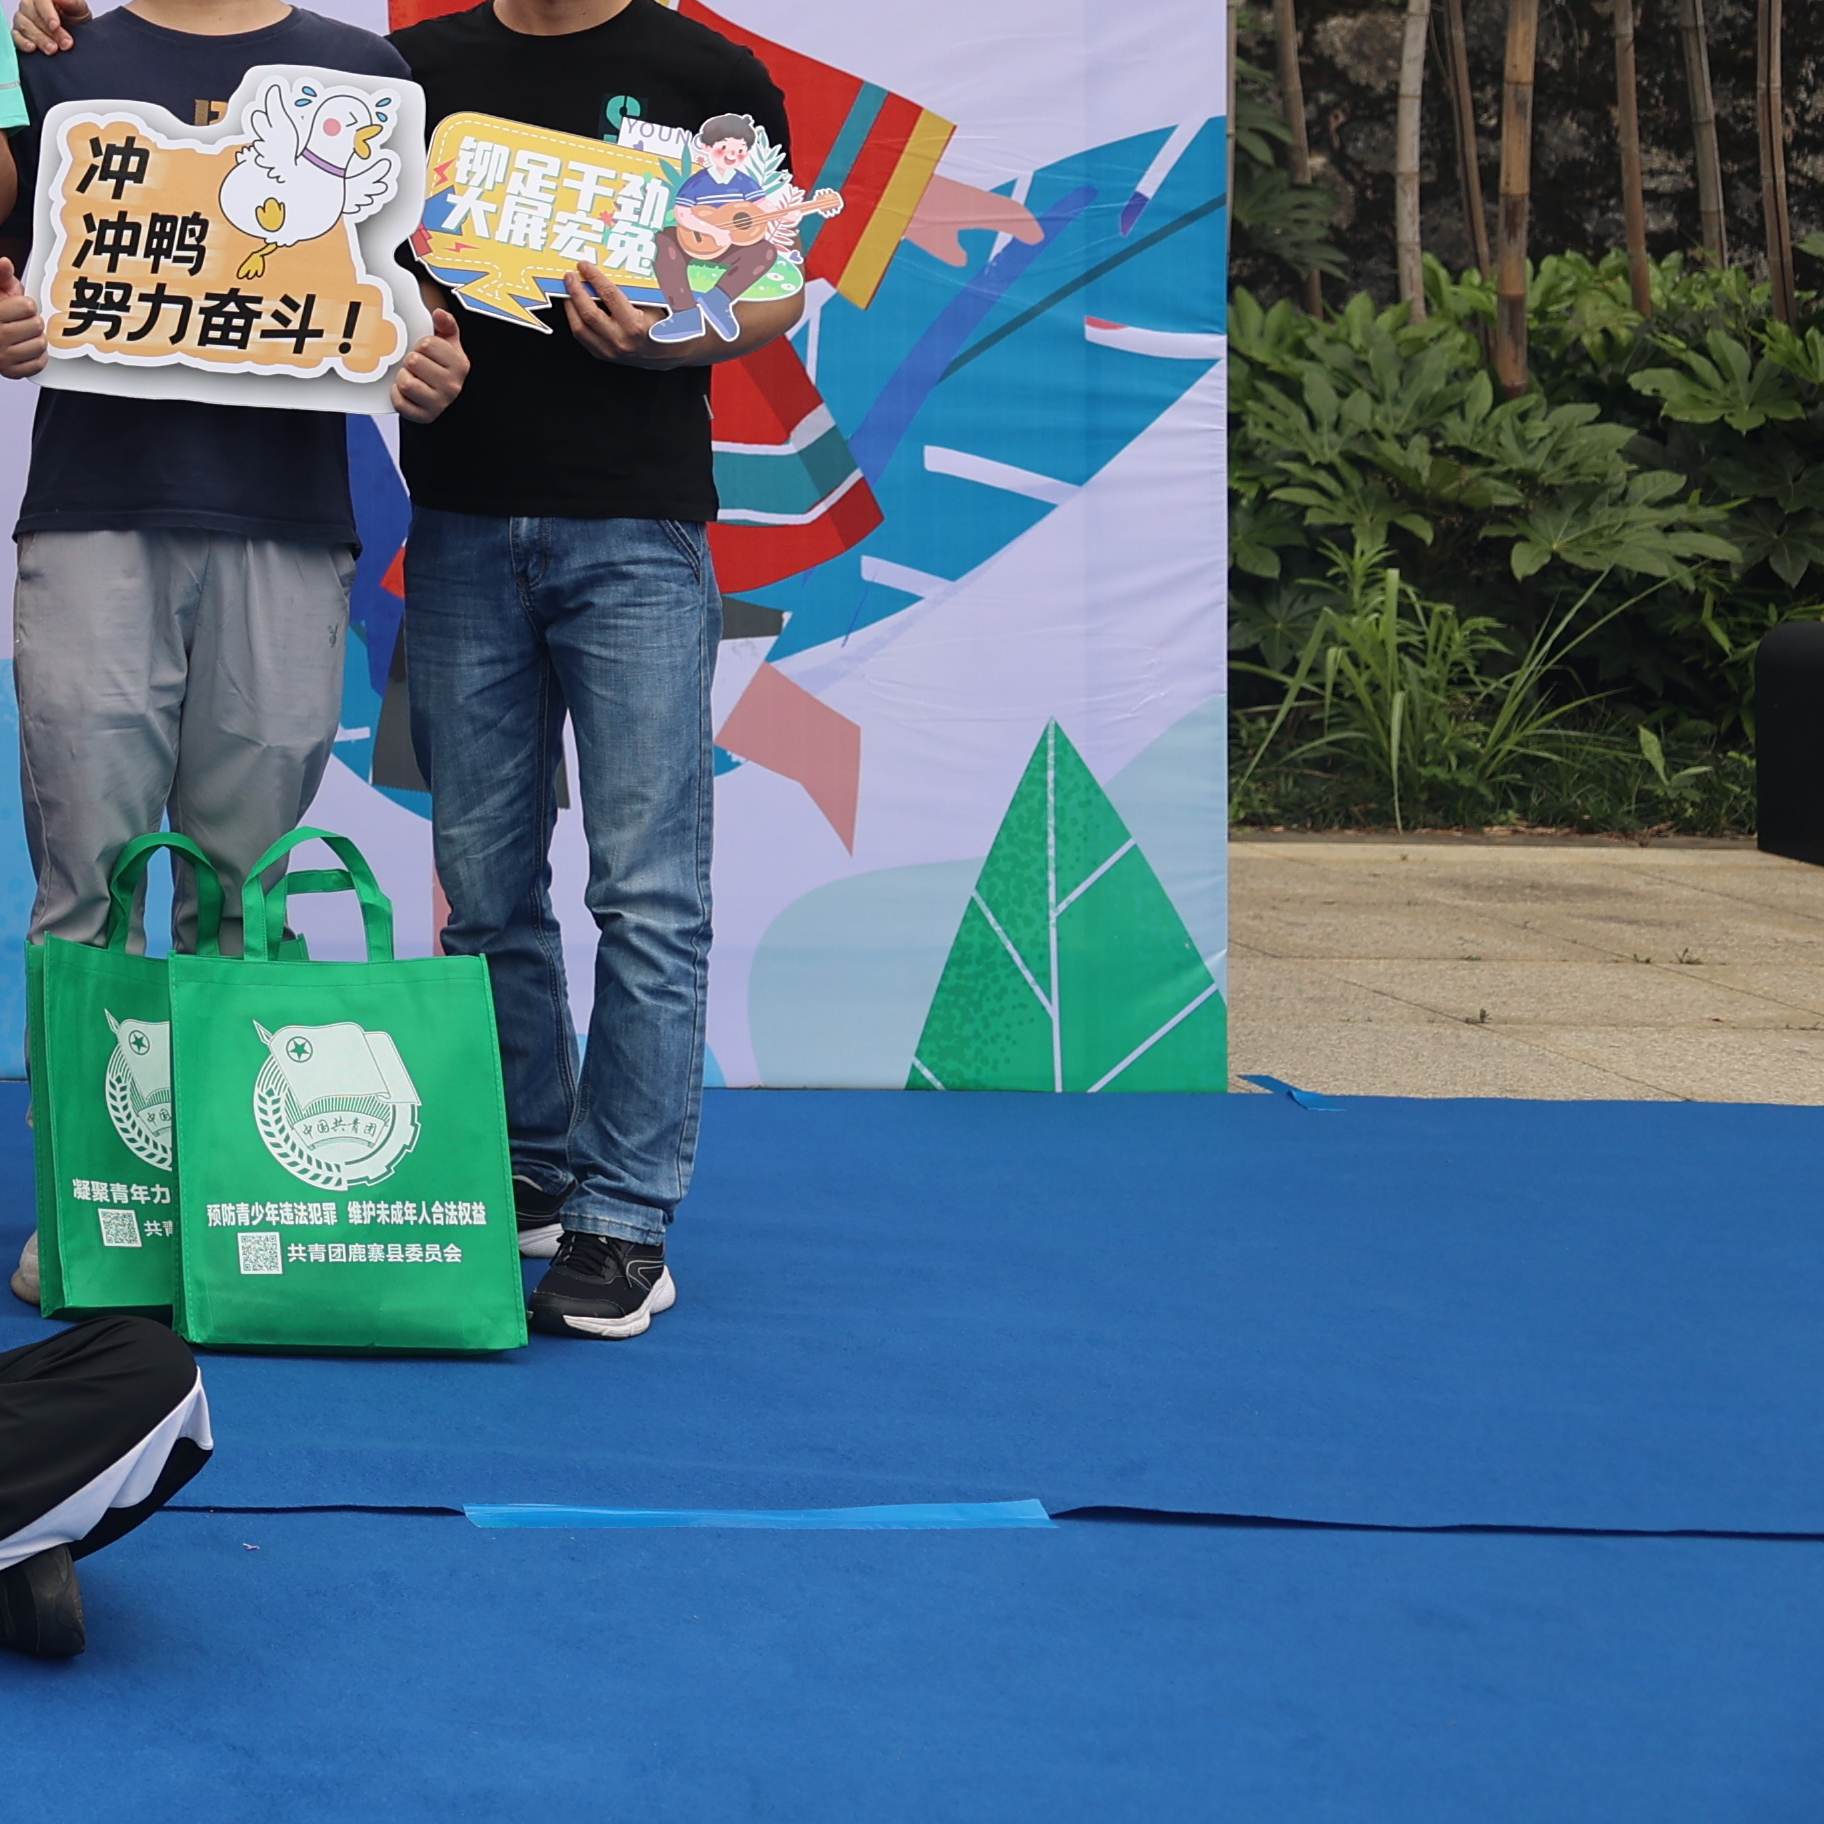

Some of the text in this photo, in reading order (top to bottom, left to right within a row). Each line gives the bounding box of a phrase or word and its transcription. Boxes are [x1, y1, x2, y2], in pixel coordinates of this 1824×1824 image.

[73, 134, 151, 202] 冲
[454, 135, 672, 231] 铆足干劲
[69, 210, 210, 279] 冲鸭
[441, 186, 657, 277] 大展宏兔
[301, 1116, 378, 1140] 中国共青团
[71, 1177, 172, 1205] 凝聚青年力
[206, 1200, 488, 1227] 预防青少年违法犯罪 维护未成年人合法权益
[286, 1242, 463, 1264] 共青团鹿寨县委员会
